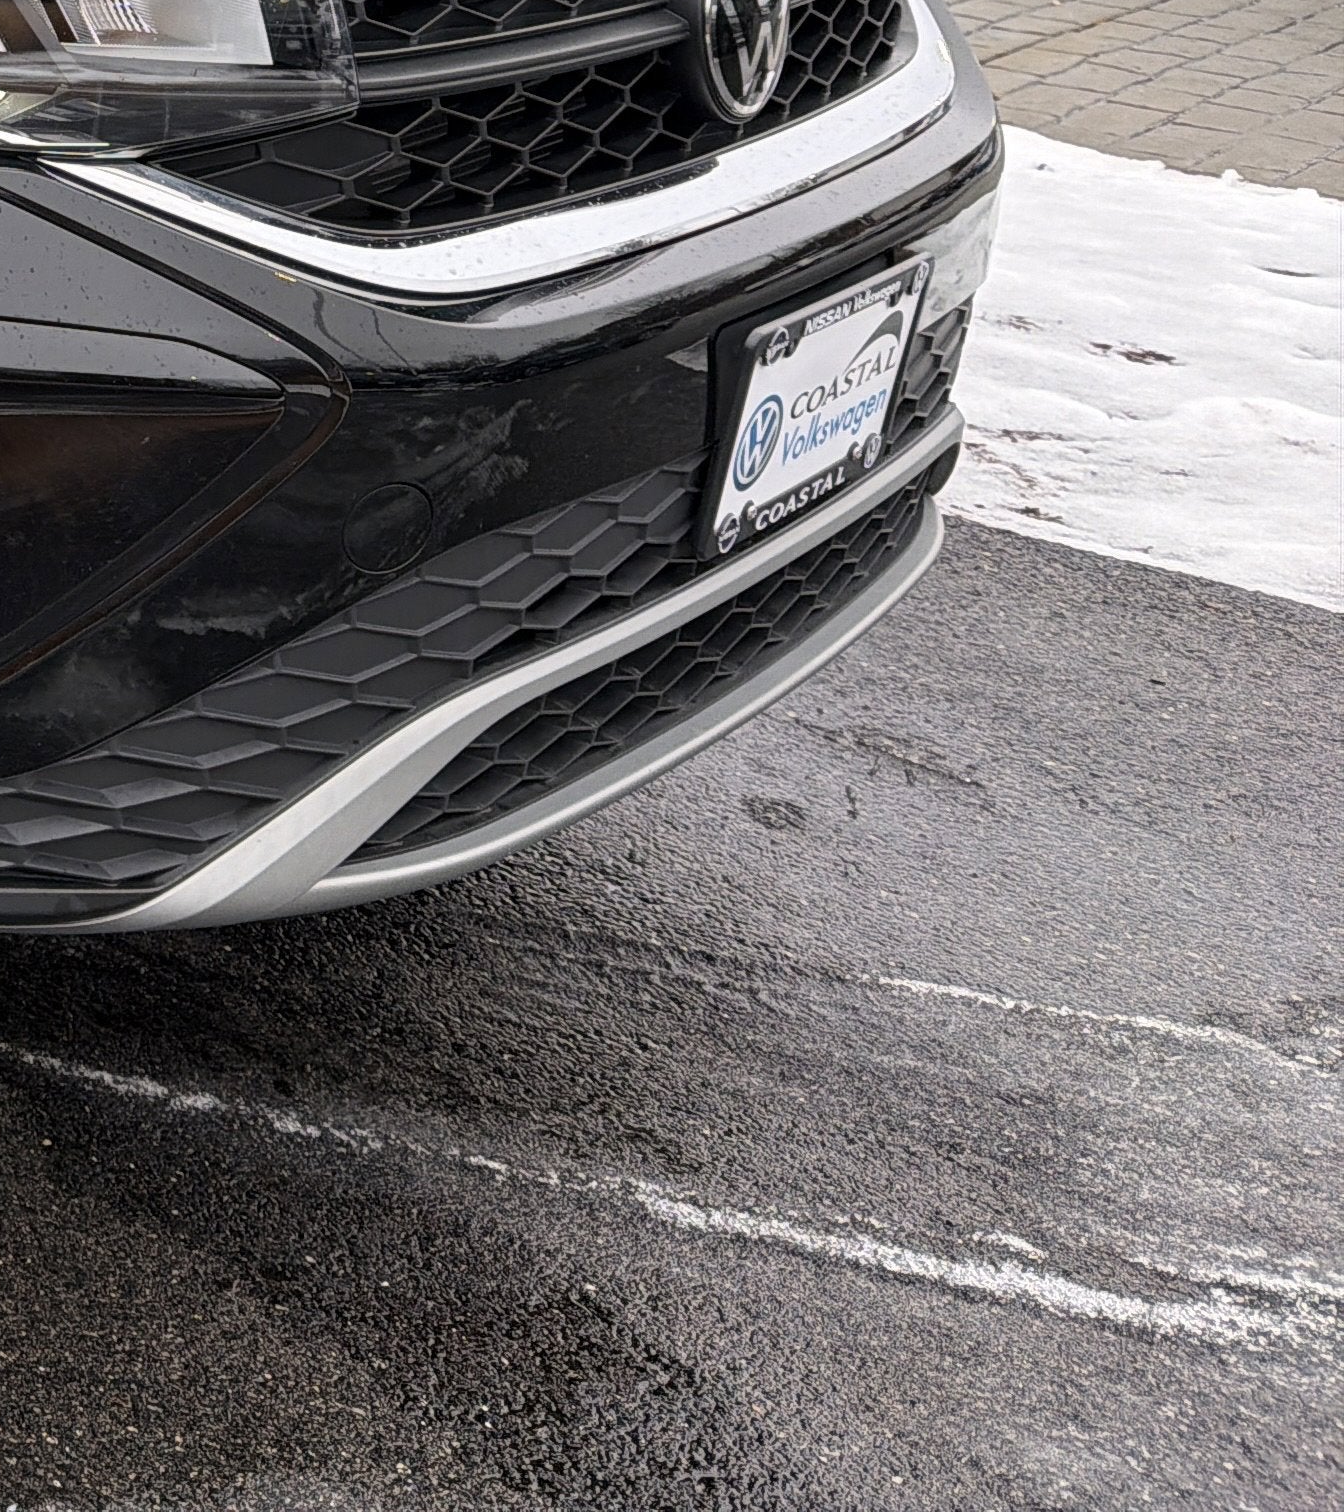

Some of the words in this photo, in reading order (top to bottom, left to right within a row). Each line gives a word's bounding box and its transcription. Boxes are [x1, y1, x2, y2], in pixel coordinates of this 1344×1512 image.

[803, 300, 853, 336] NISSAN
[790, 345, 896, 420] COASTAL
[782, 388, 887, 467] Volkswagen
[755, 466, 846, 531] COASTAL
